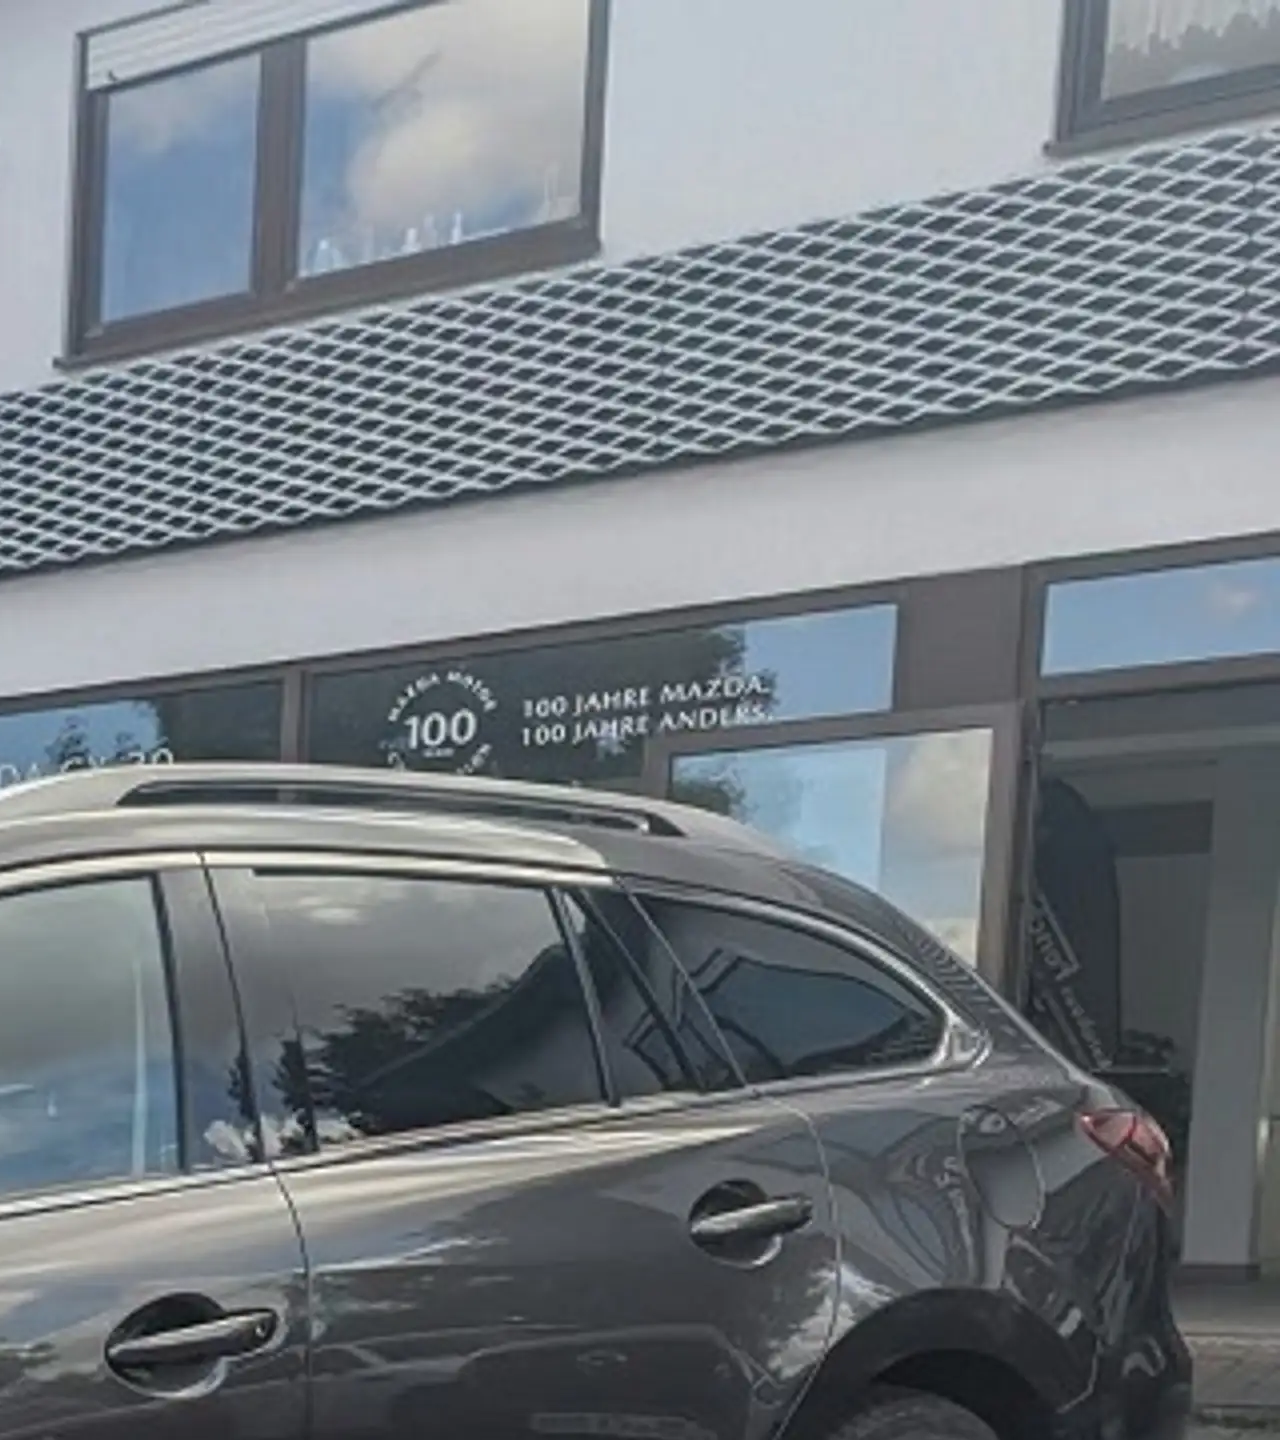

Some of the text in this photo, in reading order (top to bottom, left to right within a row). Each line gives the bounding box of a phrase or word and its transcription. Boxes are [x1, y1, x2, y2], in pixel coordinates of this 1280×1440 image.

[522, 695, 568, 718] 100
[573, 686, 649, 717] JAHRE
[404, 707, 477, 750] 100
[521, 723, 566, 747] 100
[572, 714, 649, 745] JAHRE
